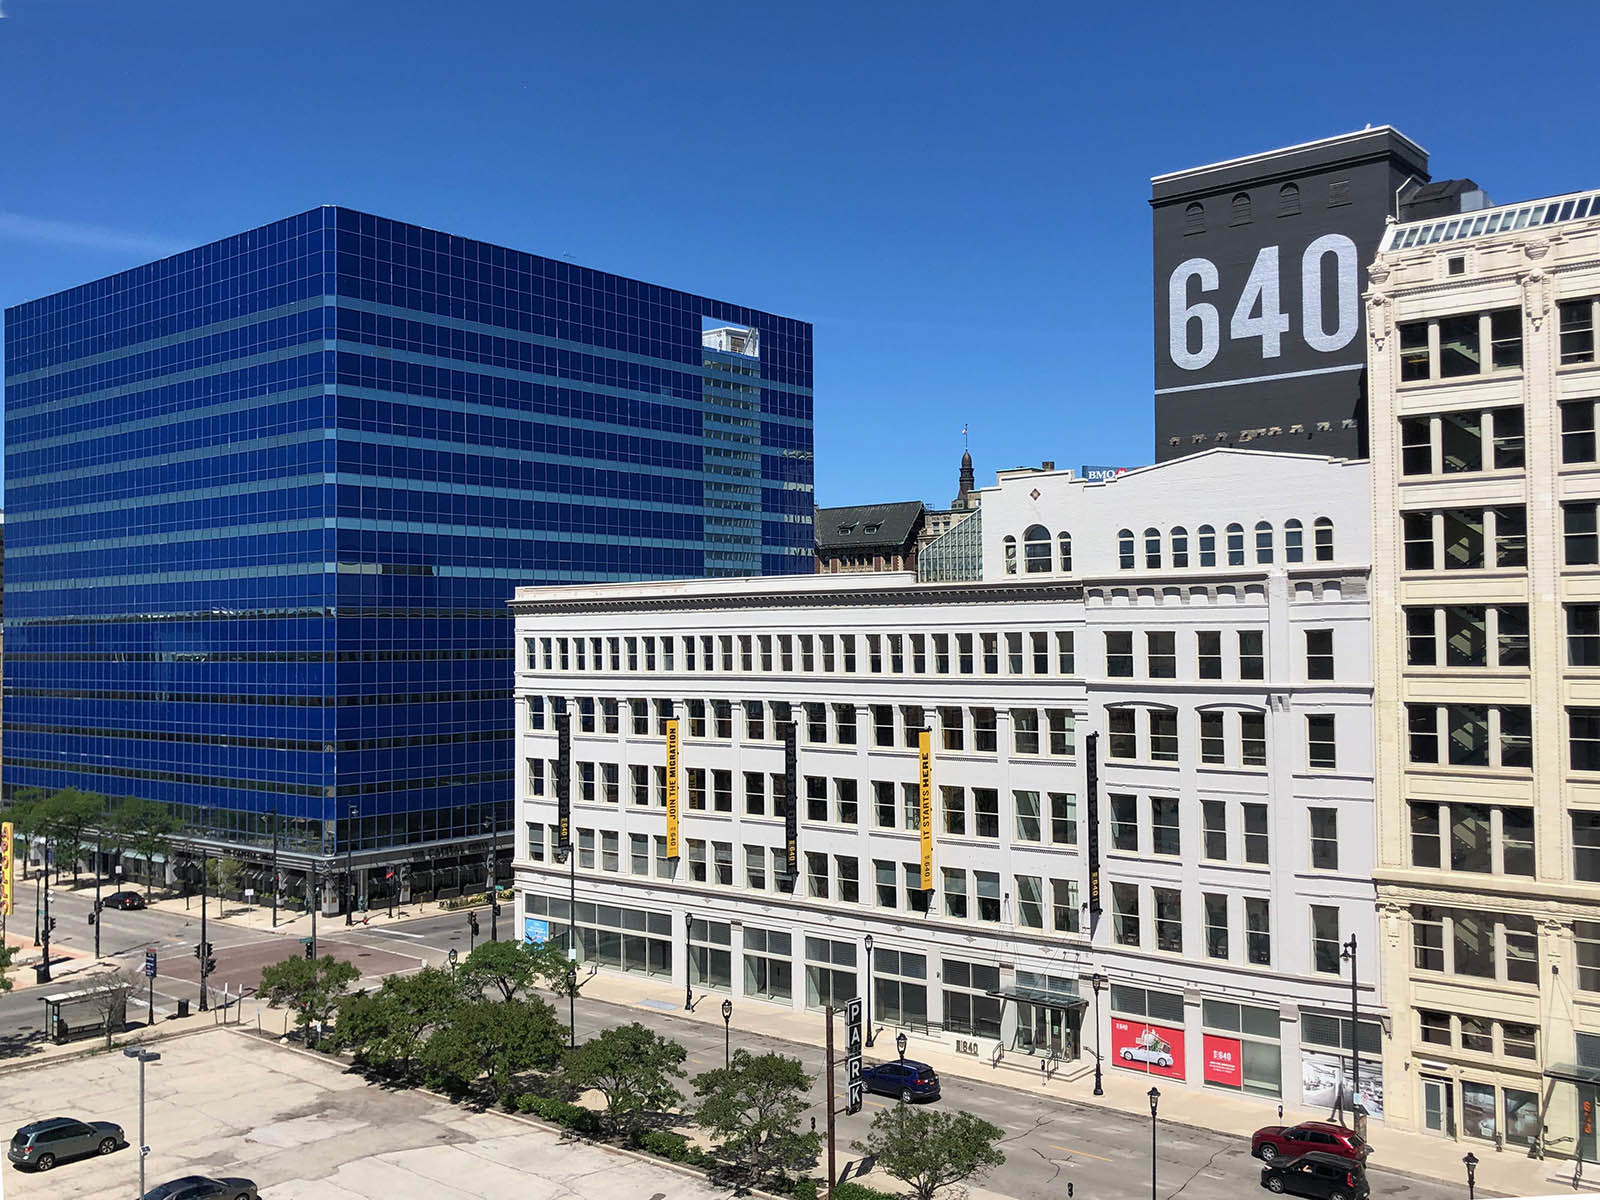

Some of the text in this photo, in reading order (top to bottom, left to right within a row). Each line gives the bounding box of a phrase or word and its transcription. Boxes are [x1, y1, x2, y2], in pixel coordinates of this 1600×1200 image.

[1169, 233, 1358, 370] 640
[1088, 470, 1116, 480] BMO
[560, 726, 569, 750] 640
[560, 754, 569, 786] 640
[560, 790, 569, 815] 640
[923, 830, 930, 840] IT
[1091, 879, 1099, 896] 640
[851, 1004, 861, 1106] PARK
